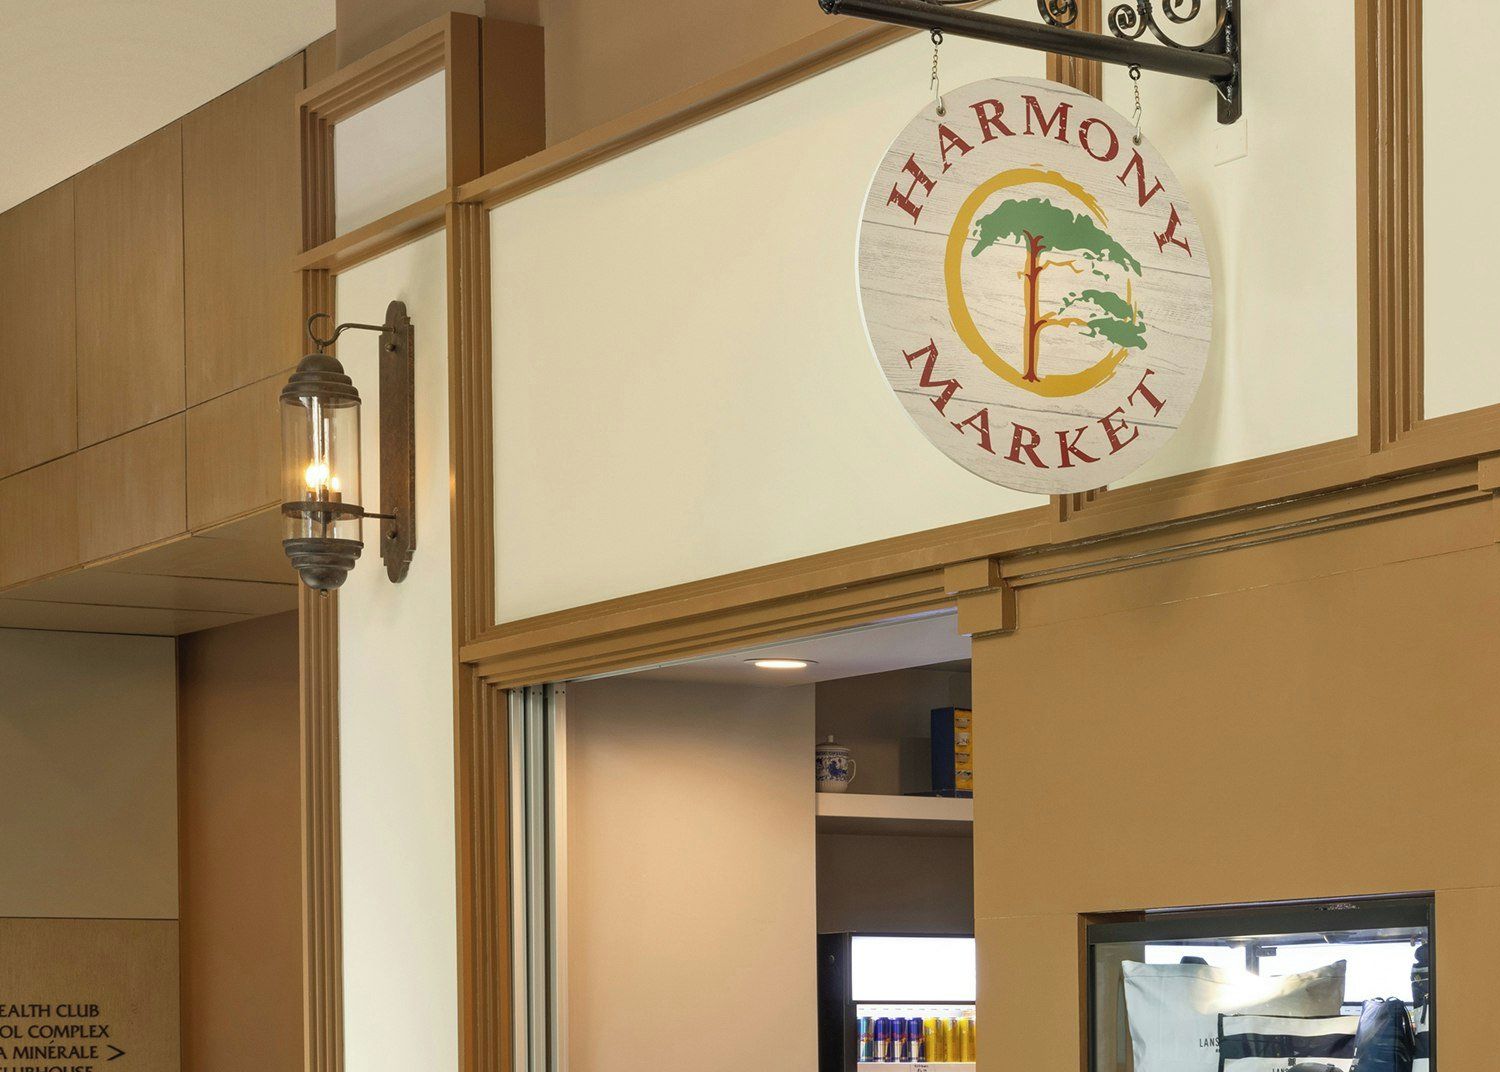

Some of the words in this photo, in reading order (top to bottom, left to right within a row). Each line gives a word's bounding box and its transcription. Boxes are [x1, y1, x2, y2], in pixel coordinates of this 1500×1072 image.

[886, 94, 1195, 259] HARMONY
[901, 337, 1168, 470] MARKET
[56, 1004, 100, 1018] CLUB
[28, 1024, 109, 1039] COMPLEX
[13, 1040, 99, 1060] MINÉRALE
